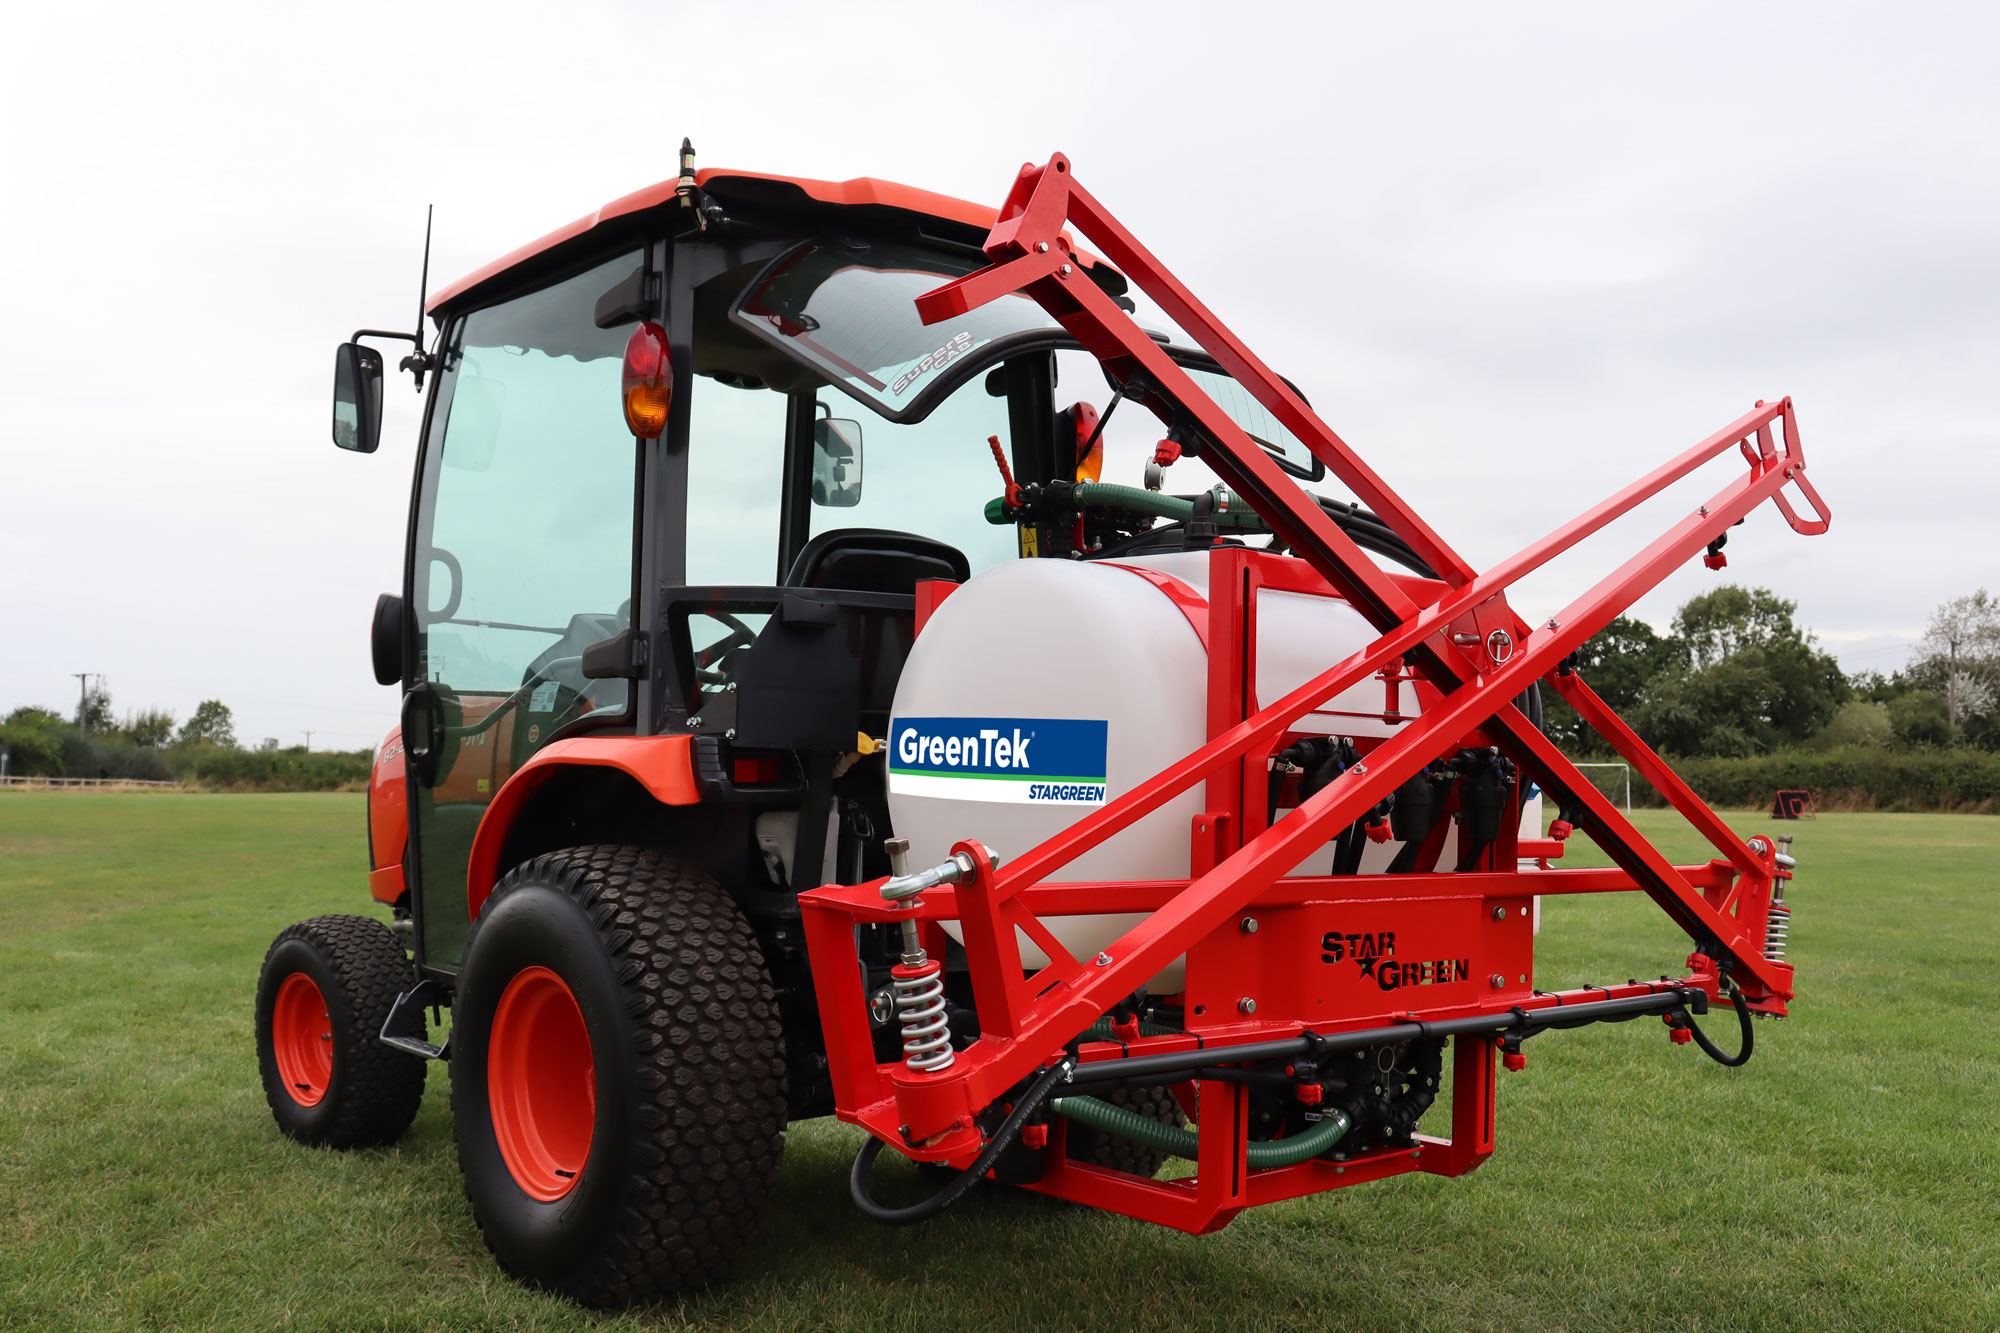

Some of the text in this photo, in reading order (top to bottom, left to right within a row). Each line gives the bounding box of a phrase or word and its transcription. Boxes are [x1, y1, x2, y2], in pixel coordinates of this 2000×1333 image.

[899, 728, 1031, 768] GreenTek
[1028, 784, 1105, 801] STARGREEN
[1321, 931, 1396, 964] STAR
[1377, 958, 1469, 992] GREEN
[978, 1152, 999, 1177] PETROL
[998, 1134, 1011, 1153] HOSE
